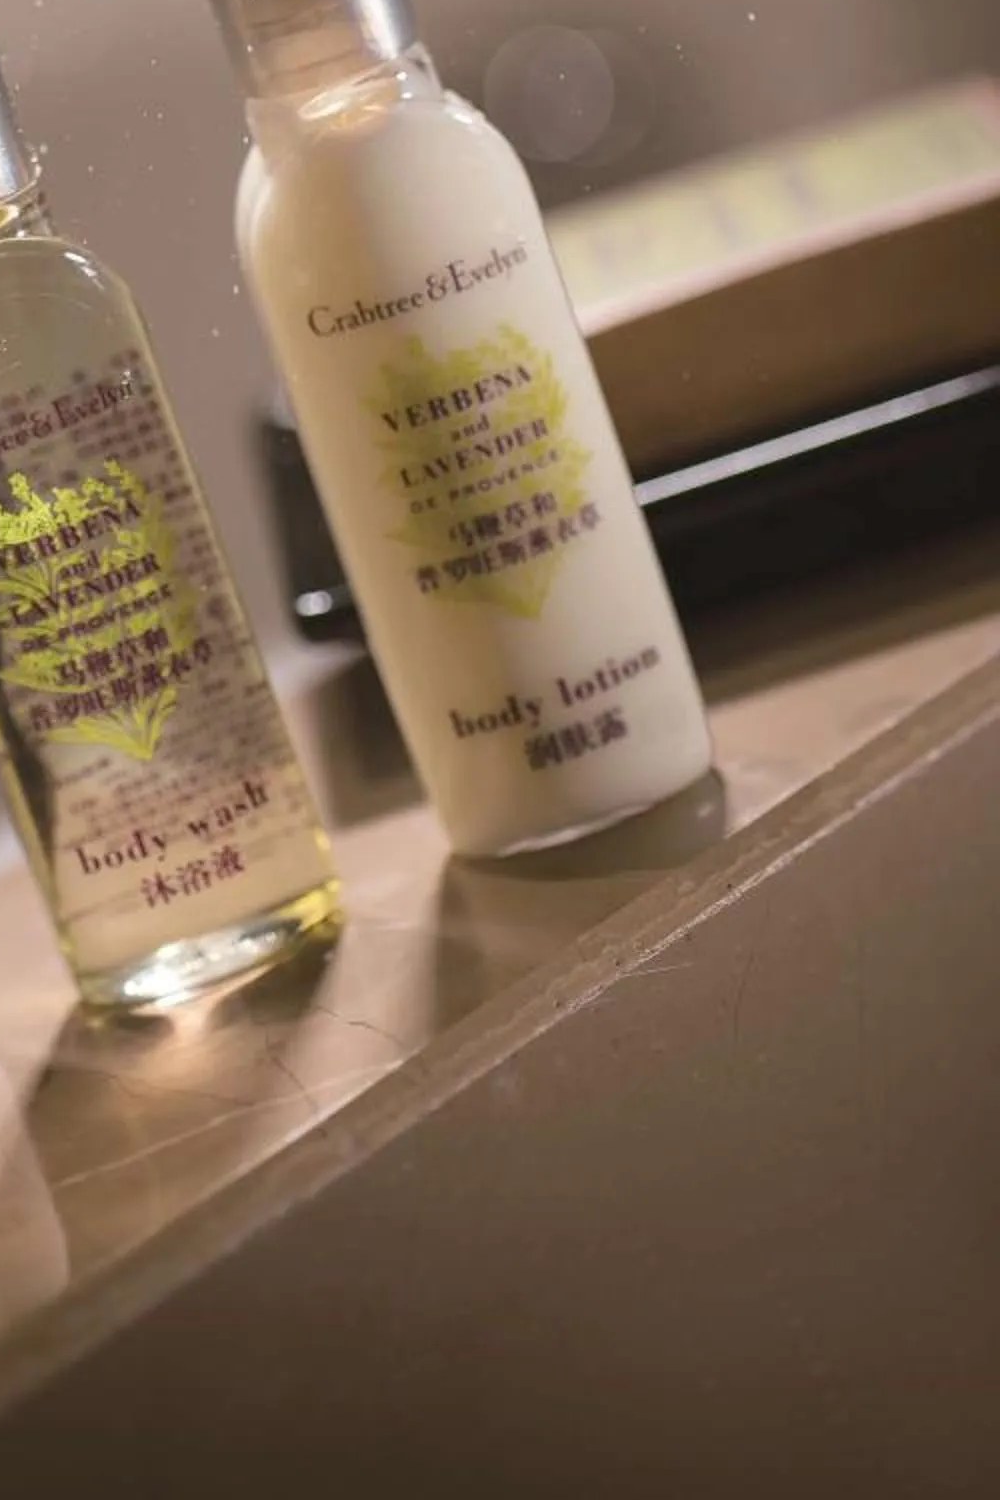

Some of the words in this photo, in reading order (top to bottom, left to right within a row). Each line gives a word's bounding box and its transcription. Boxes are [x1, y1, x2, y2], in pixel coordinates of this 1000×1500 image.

[382, 362, 532, 434] VERBENA
[450, 416, 490, 442] and
[400, 418, 549, 489] LAVENDER
[10, 555, 162, 628] LAVENDER
[59, 555, 100, 581] and
[450, 692, 542, 740] body
[558, 645, 661, 708] lotion
[78, 828, 169, 876] body
[188, 781, 270, 838] wash
[140, 845, 246, 908] 沐浴液
